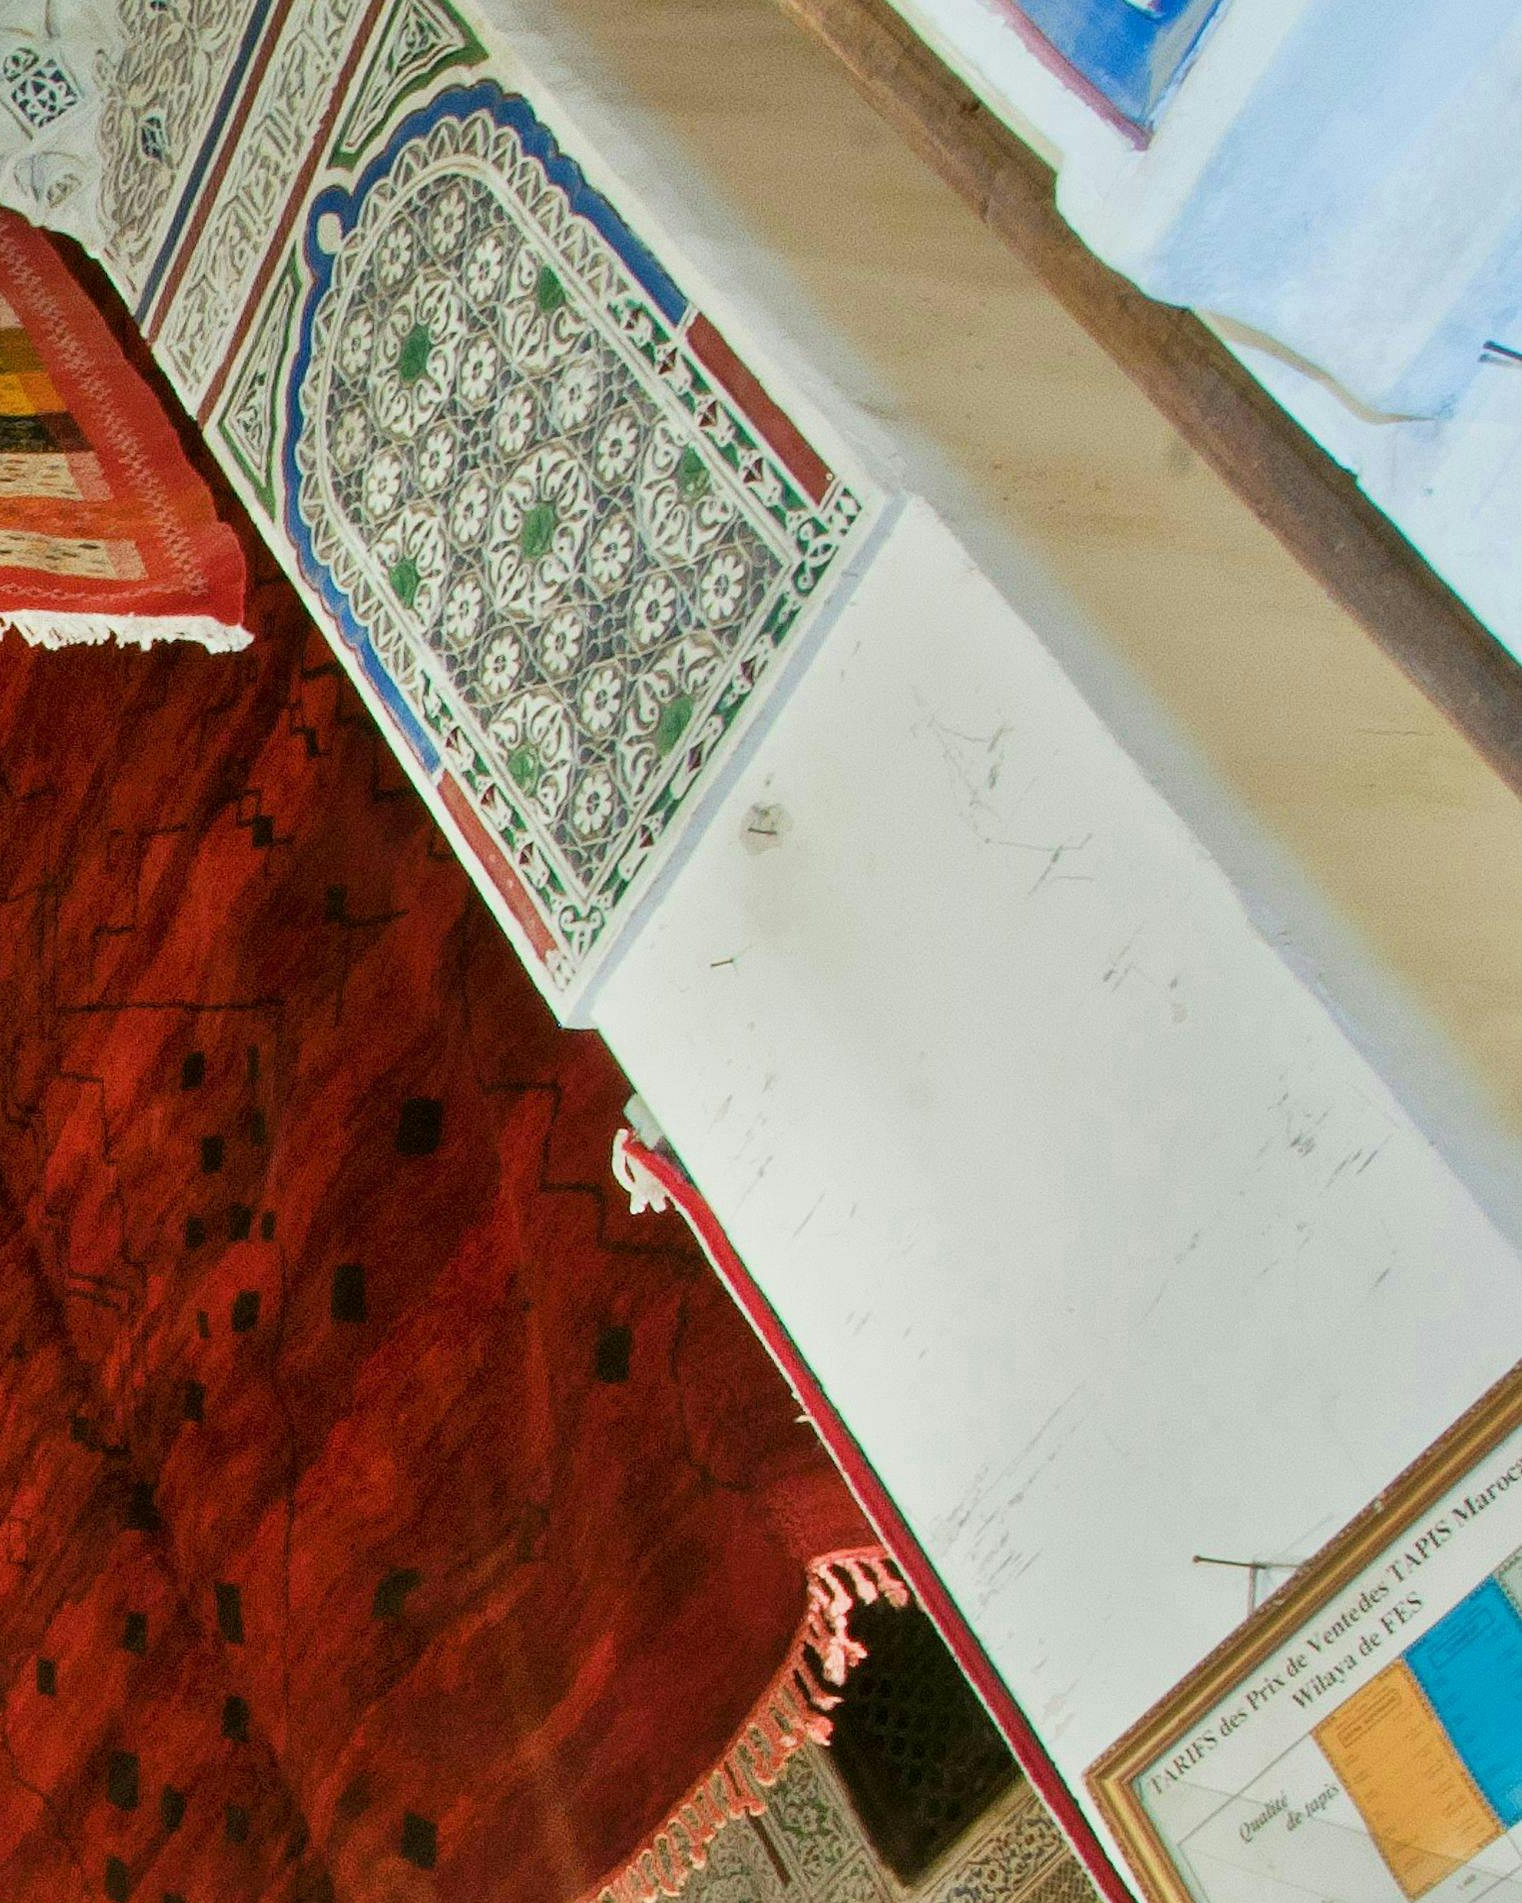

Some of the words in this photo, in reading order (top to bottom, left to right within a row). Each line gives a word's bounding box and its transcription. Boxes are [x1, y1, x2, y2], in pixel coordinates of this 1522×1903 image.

[1149, 1730, 1218, 1795] TARIFS
[1220, 1708, 1249, 1737] des
[1246, 1675, 1285, 1710] Prix
[1286, 1653, 1308, 1677] de
[1386, 1519, 1452, 1582] TAPIS
[1292, 1654, 1358, 1709] Wilaya
[1359, 1632, 1381, 1656] de
[1380, 1591, 1423, 1635] FES
[1286, 1811, 1303, 1831] de
[1304, 1784, 1339, 1817] tapis
